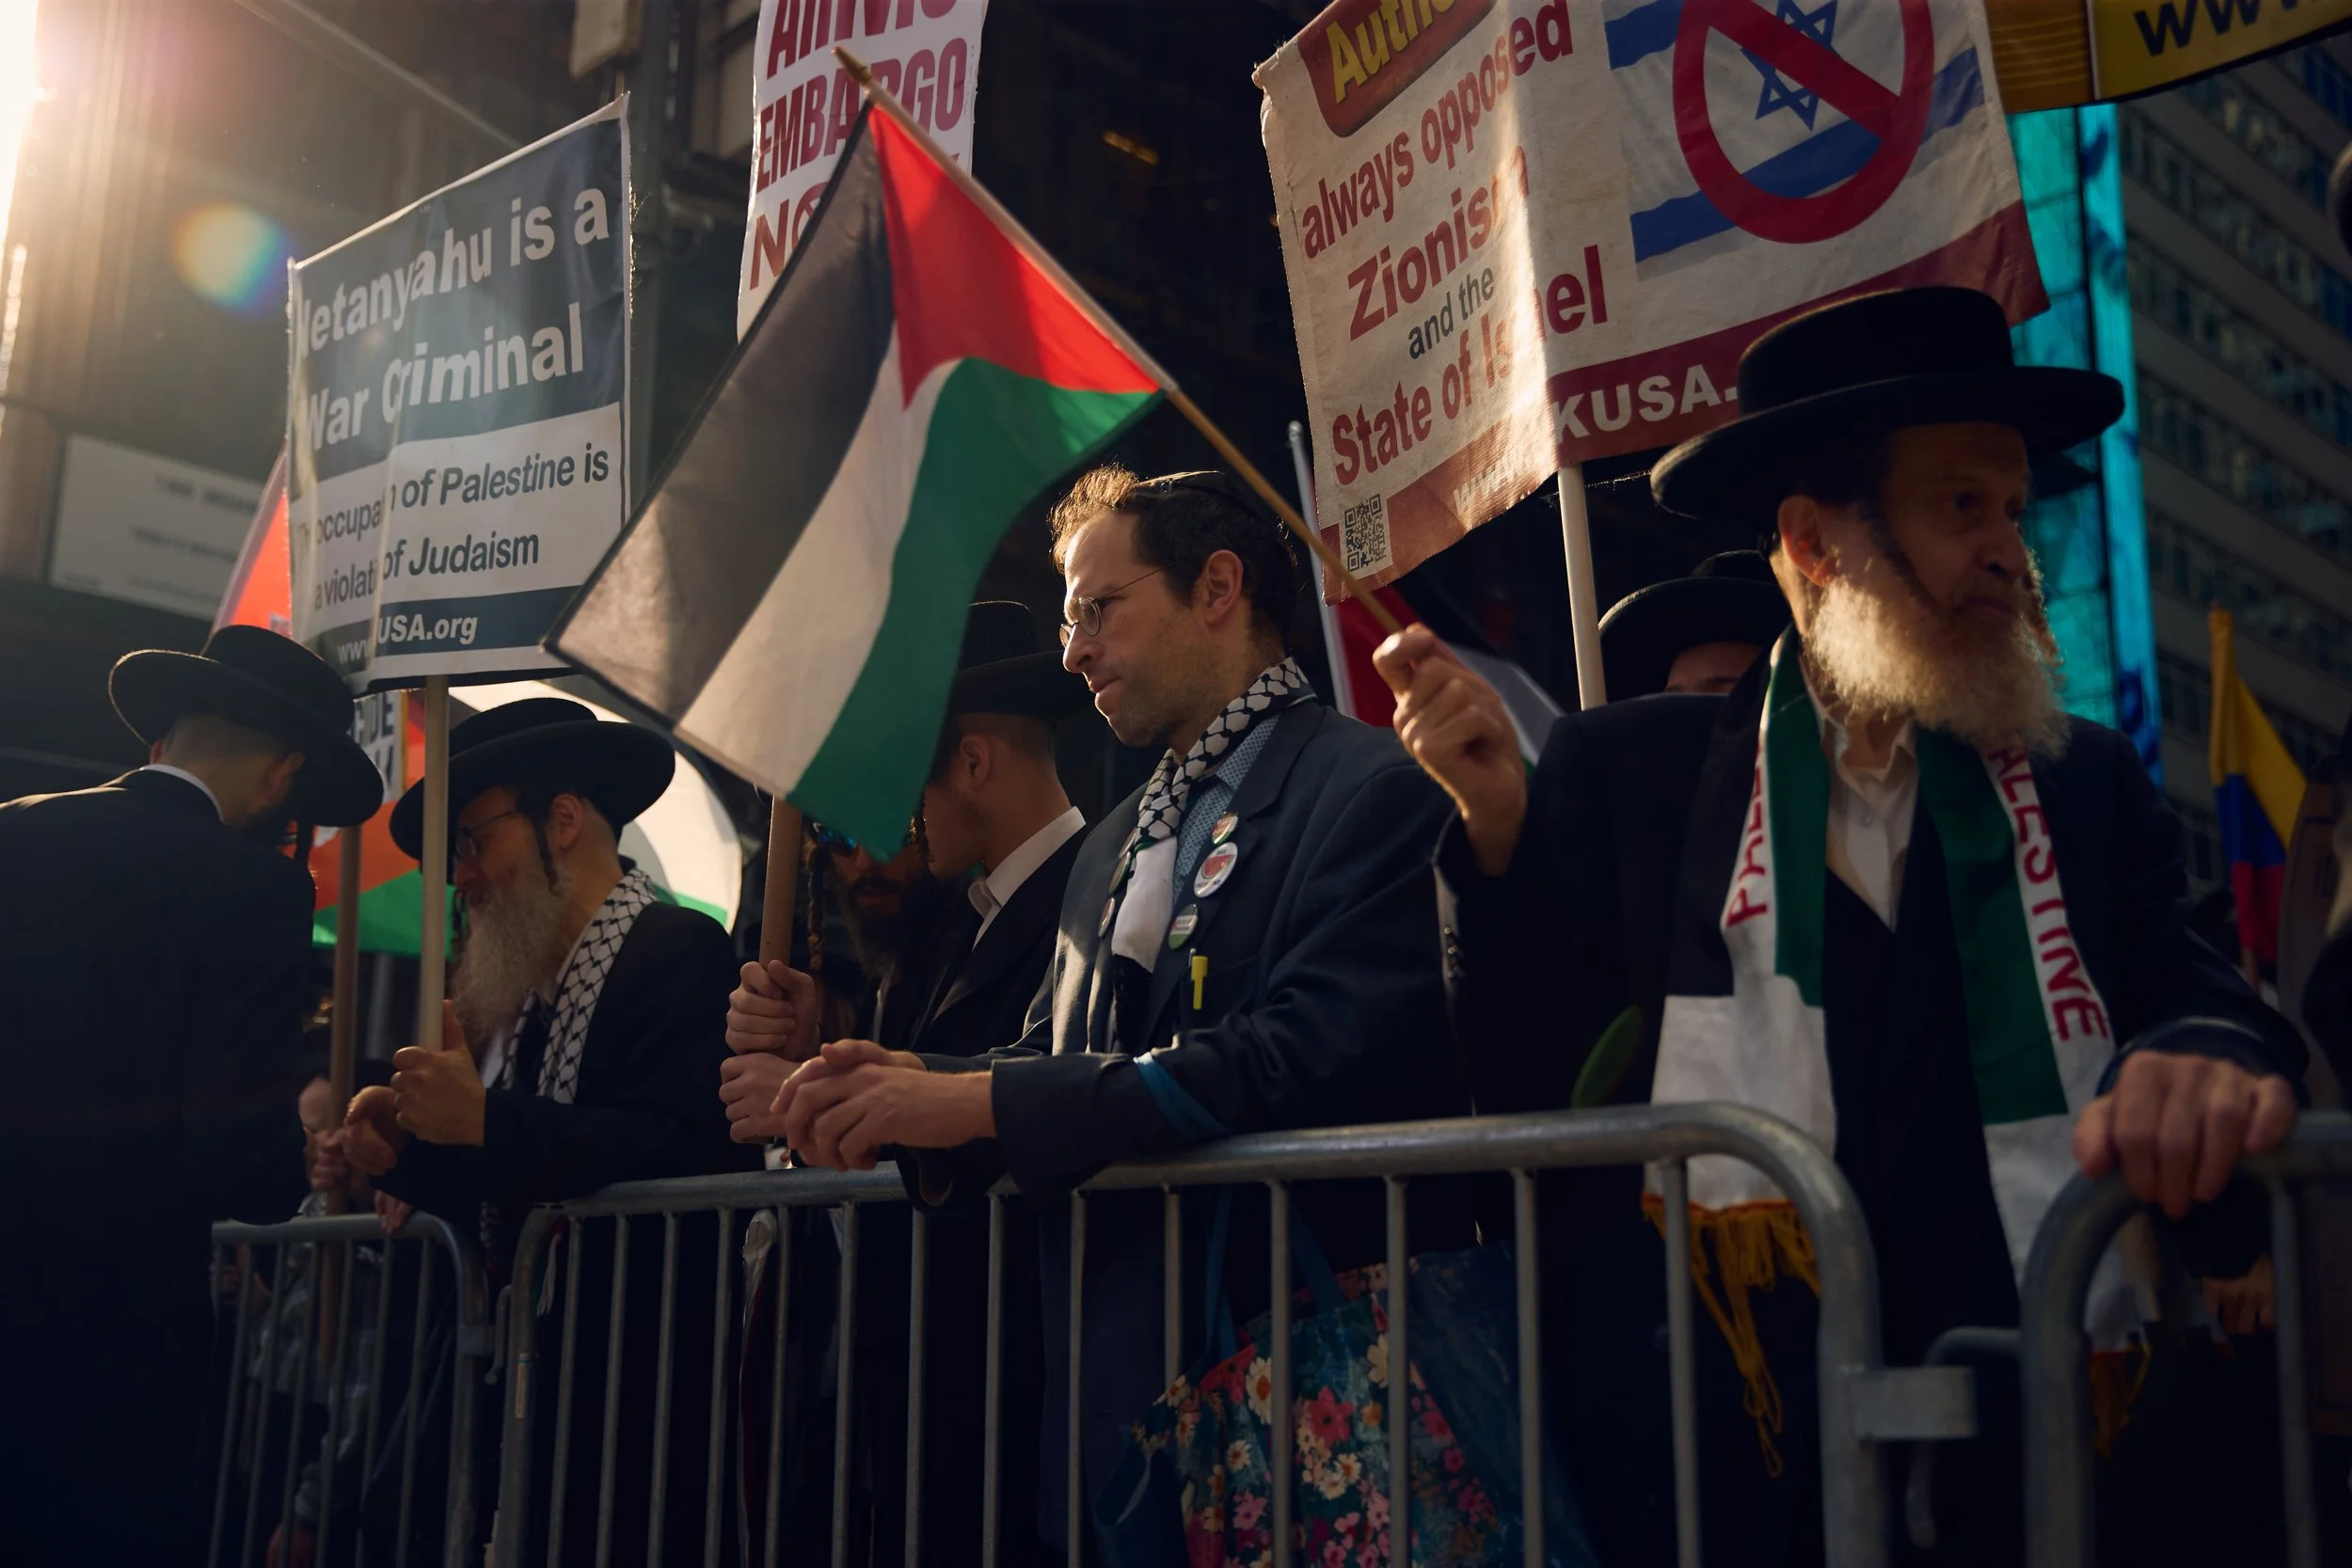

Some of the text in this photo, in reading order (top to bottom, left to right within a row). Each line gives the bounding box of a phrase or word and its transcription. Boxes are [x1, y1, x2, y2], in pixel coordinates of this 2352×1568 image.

[1302, 0, 1574, 260] always opposed
[510, 197, 556, 268] is
[573, 188, 610, 247] a
[1408, 268, 1495, 359] and the
[382, 302, 584, 424] Criminal
[1332, 381, 1433, 486] State
[1441, 331, 1473, 420] of
[402, 468, 437, 509] of
[439, 453, 576, 506] Palestine
[584, 442, 610, 485] is
[408, 531, 540, 577] Judaism
